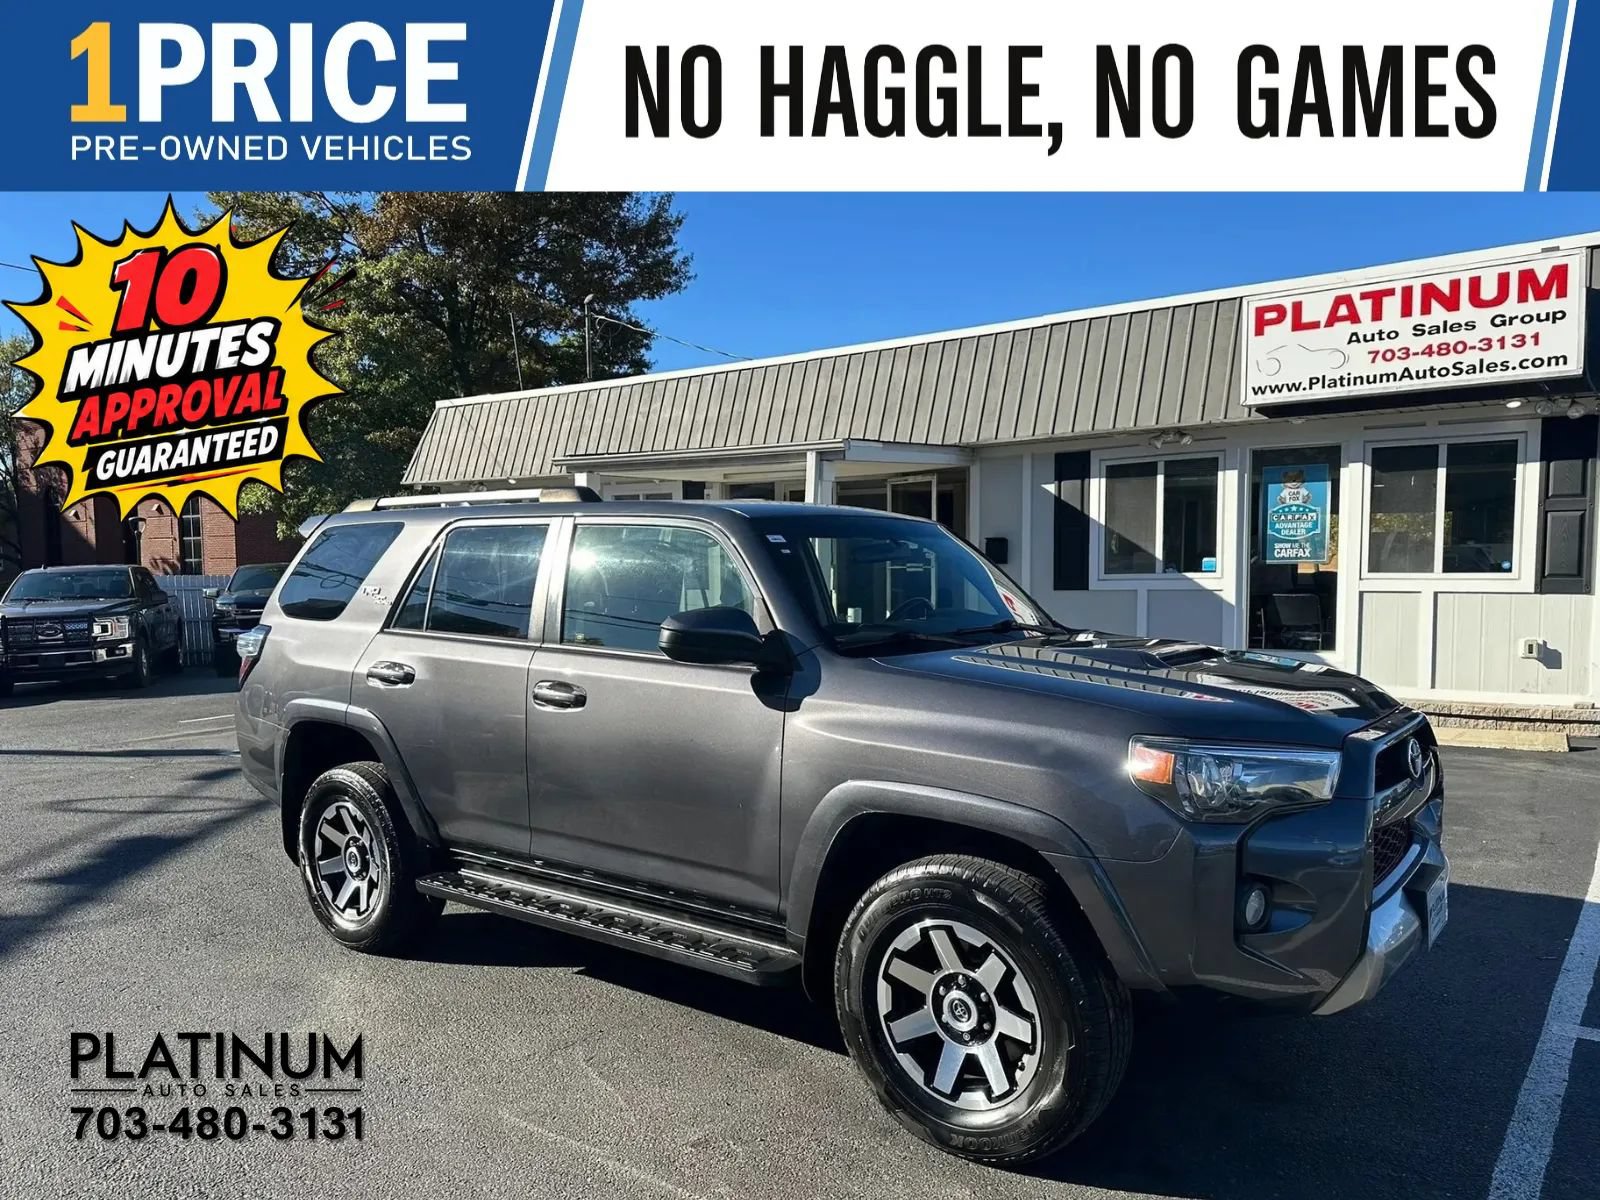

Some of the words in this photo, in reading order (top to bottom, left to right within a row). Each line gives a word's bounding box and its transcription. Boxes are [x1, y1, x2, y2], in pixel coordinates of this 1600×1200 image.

[1254, 263, 1569, 337] PLATINUM
[1347, 327, 1400, 345] Auto
[1411, 319, 1477, 338] Sales
[1490, 308, 1567, 329] Group
[1367, 332, 1541, 364] 703-480-3131
[1251, 353, 1568, 396] www.PlatinumAutoSales.com
[1273, 513, 1317, 521] CARFAX
[1274, 521, 1313, 529] ADVANTAGE
[1281, 528, 1306, 536] DEALER
[1274, 548, 1311, 558] CARFAX
